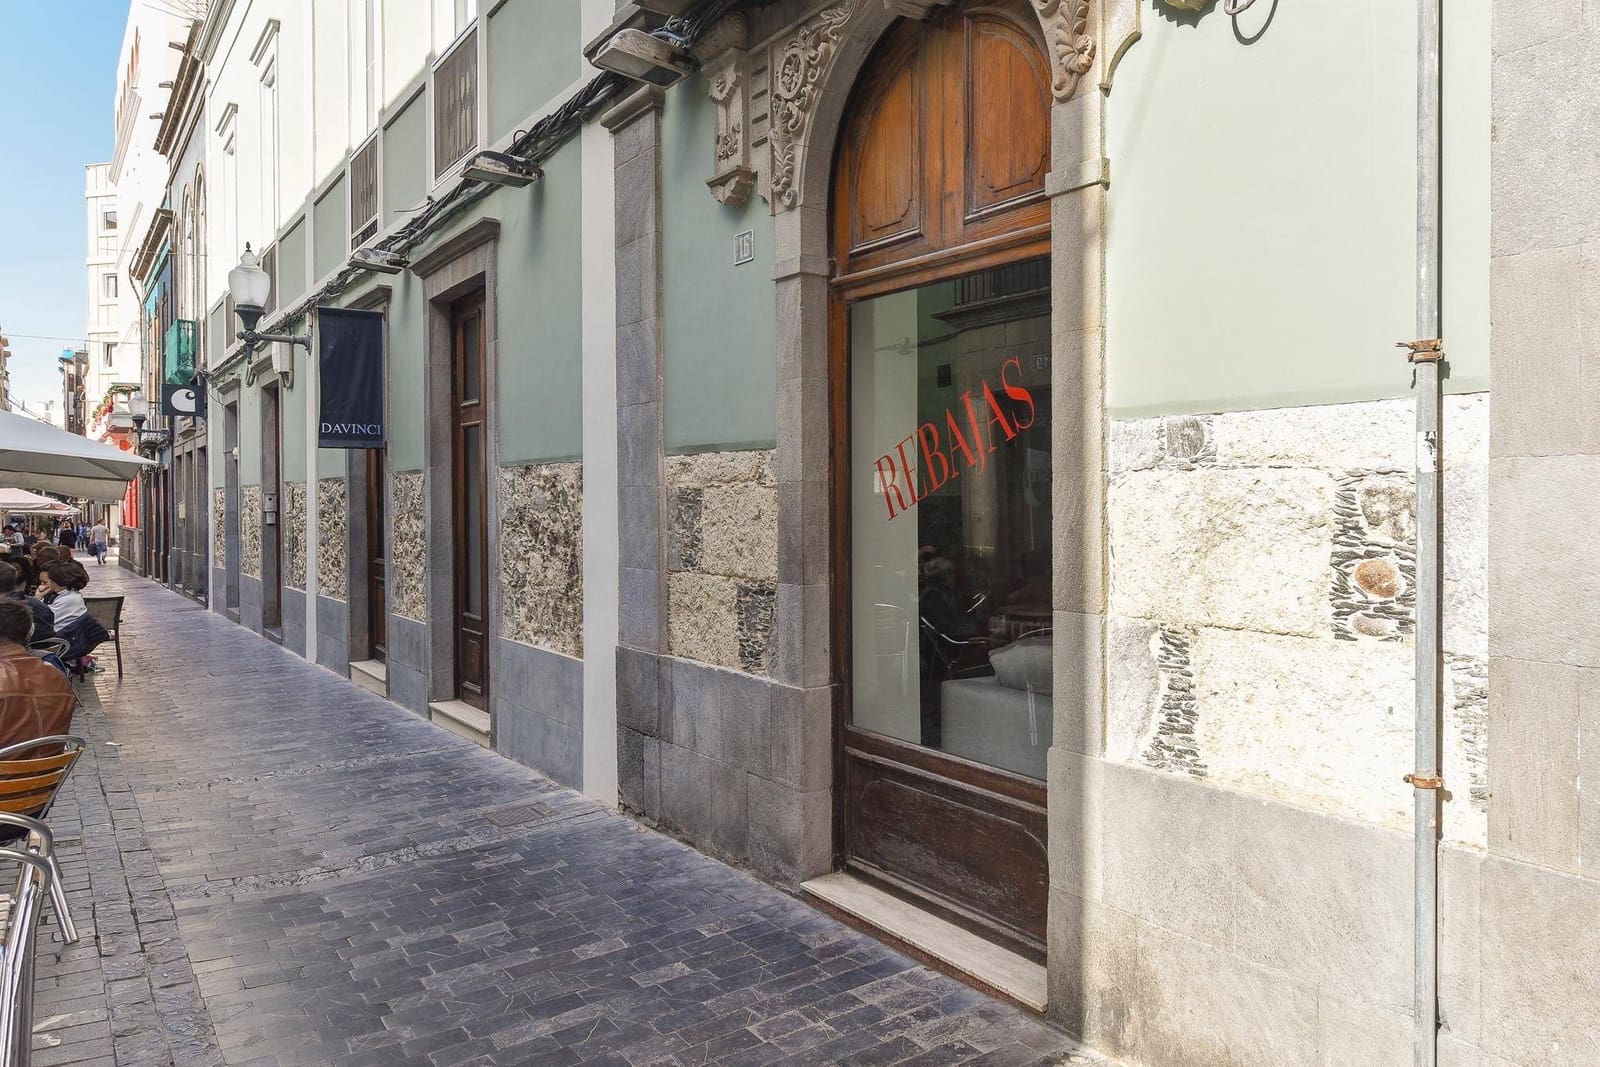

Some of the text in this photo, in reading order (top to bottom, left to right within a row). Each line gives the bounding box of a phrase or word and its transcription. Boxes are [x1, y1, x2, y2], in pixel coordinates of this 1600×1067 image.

[739, 233, 750, 260] 16
[321, 422, 382, 435] DAVINCI
[873, 355, 1036, 521] REBAJAS
